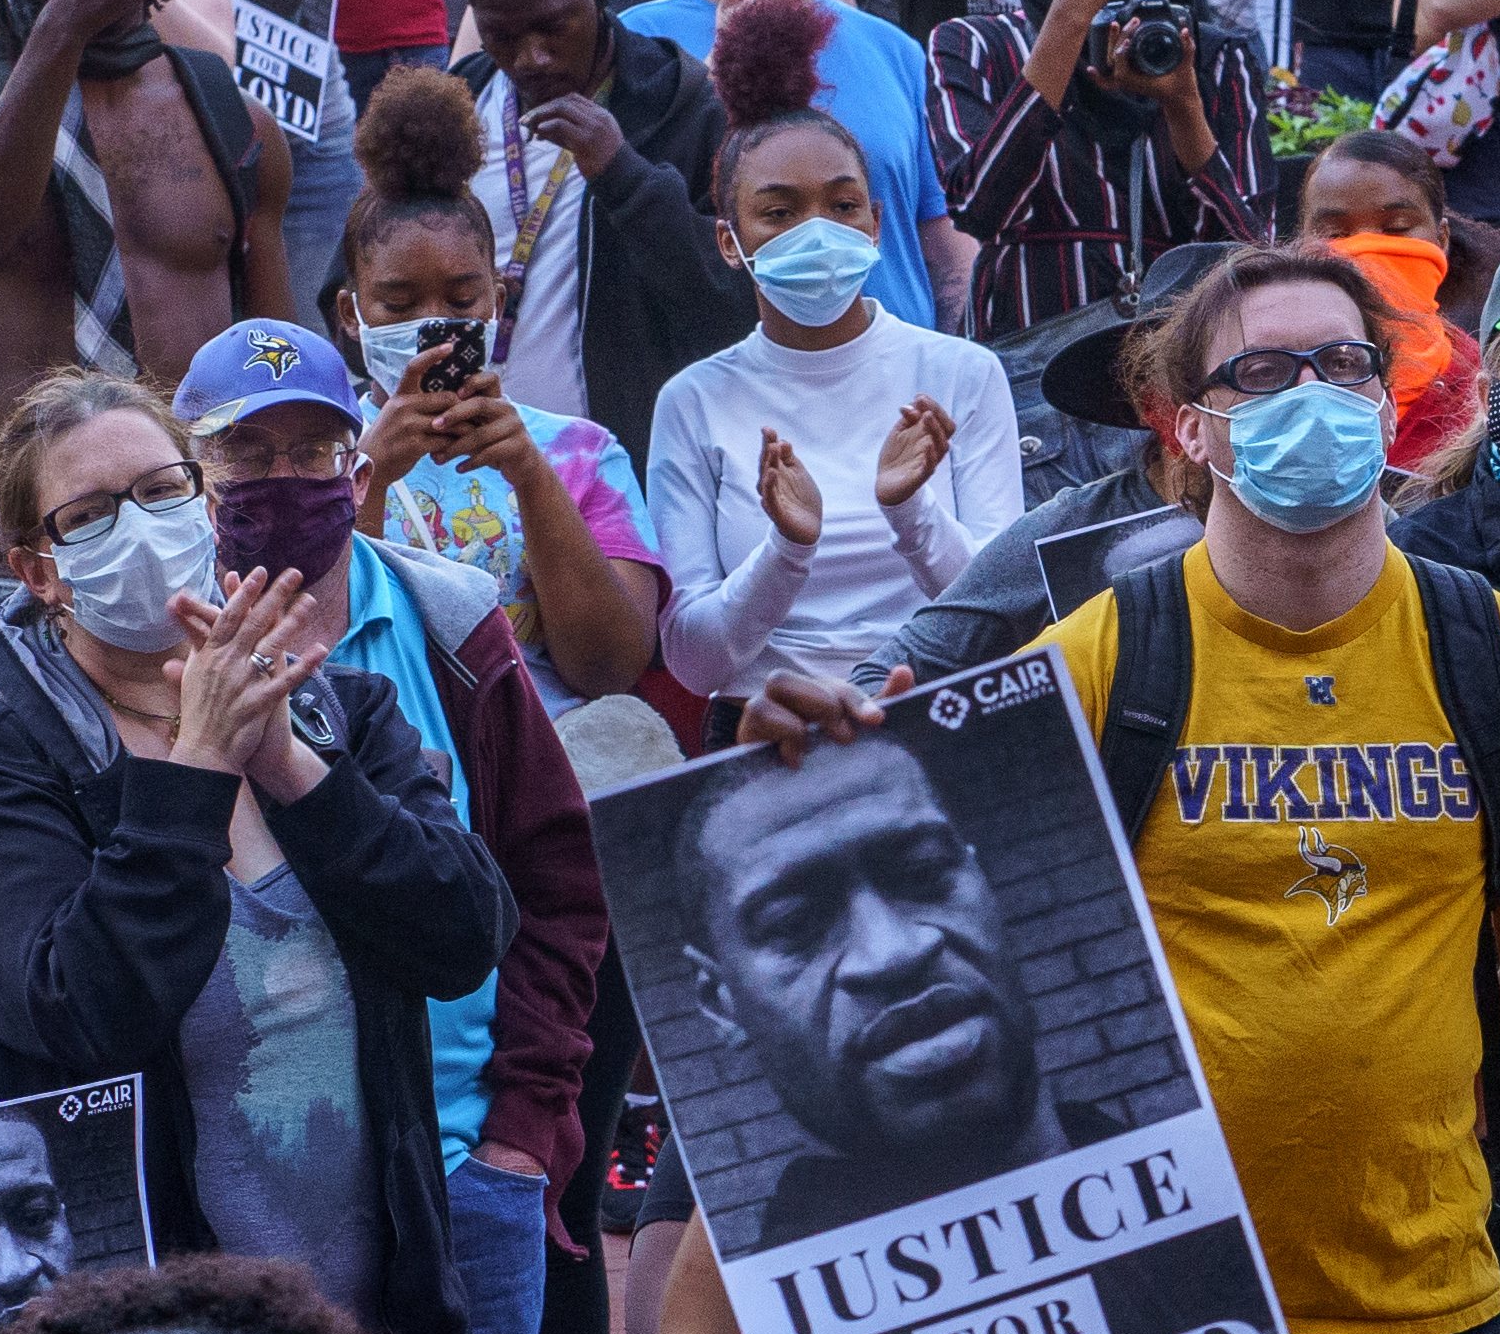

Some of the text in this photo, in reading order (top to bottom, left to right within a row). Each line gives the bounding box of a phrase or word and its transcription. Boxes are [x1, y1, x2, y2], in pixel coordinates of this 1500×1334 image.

[233, 5, 320, 71] USTICE
[247, 48, 284, 79] FOR
[233, 70, 318, 131] LOYD
[973, 659, 1056, 708] CAIR
[981, 683, 1056, 715] MINNESOTA
[1170, 741, 1482, 825] VIKINGS
[85, 1083, 134, 1109] CAIR
